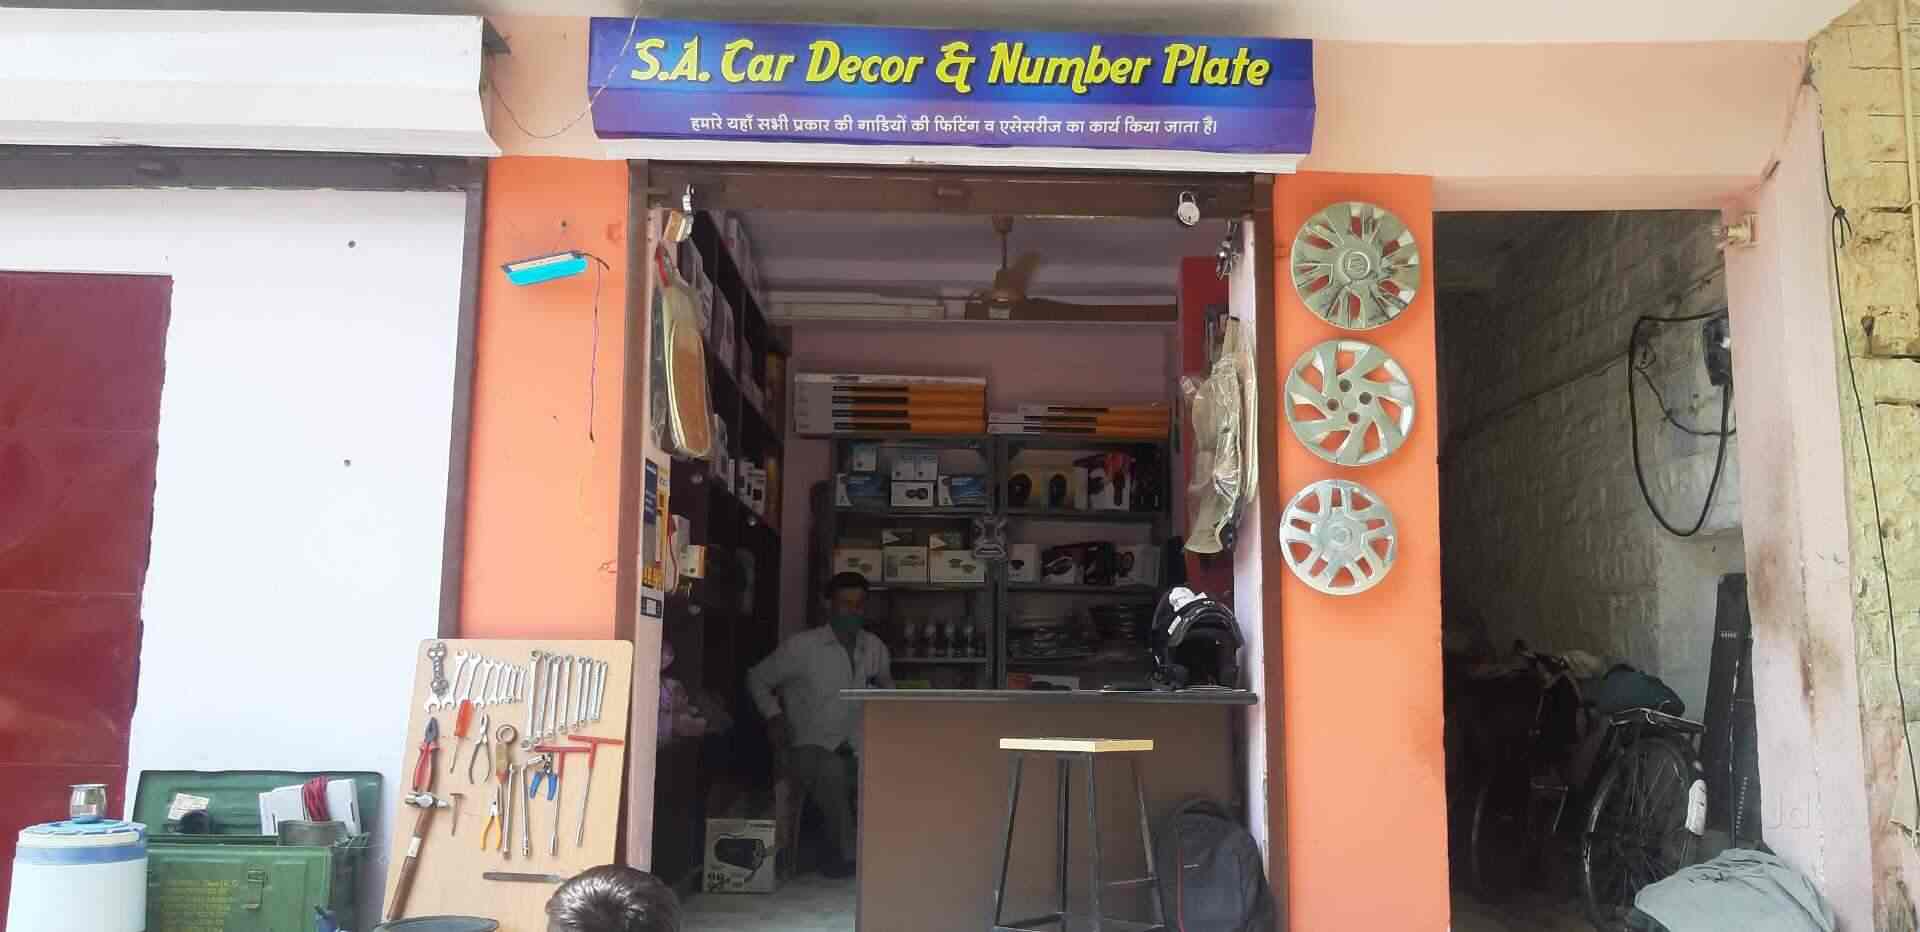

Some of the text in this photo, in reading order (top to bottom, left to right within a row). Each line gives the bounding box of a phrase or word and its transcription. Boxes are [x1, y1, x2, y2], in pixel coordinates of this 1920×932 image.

[631, 35, 1272, 95] S.A. Car Decor & Number Plate
[690, 112, 722, 131] हमारे
[726, 113, 753, 132] यहाँ
[756, 113, 789, 131] सभी
[792, 118, 830, 131] प्रकार
[833, 114, 853, 131] की
[911, 115, 929, 132] की
[934, 115, 980, 132] फिटिंग
[983, 120, 995, 132] व
[999, 114, 1062, 135] एसेसरीज
[1064, 120, 1086, 132] का
[1088, 115, 1122, 133] कार्य
[1124, 115, 1161, 133] किया
[1163, 120, 1200, 133] जाता
